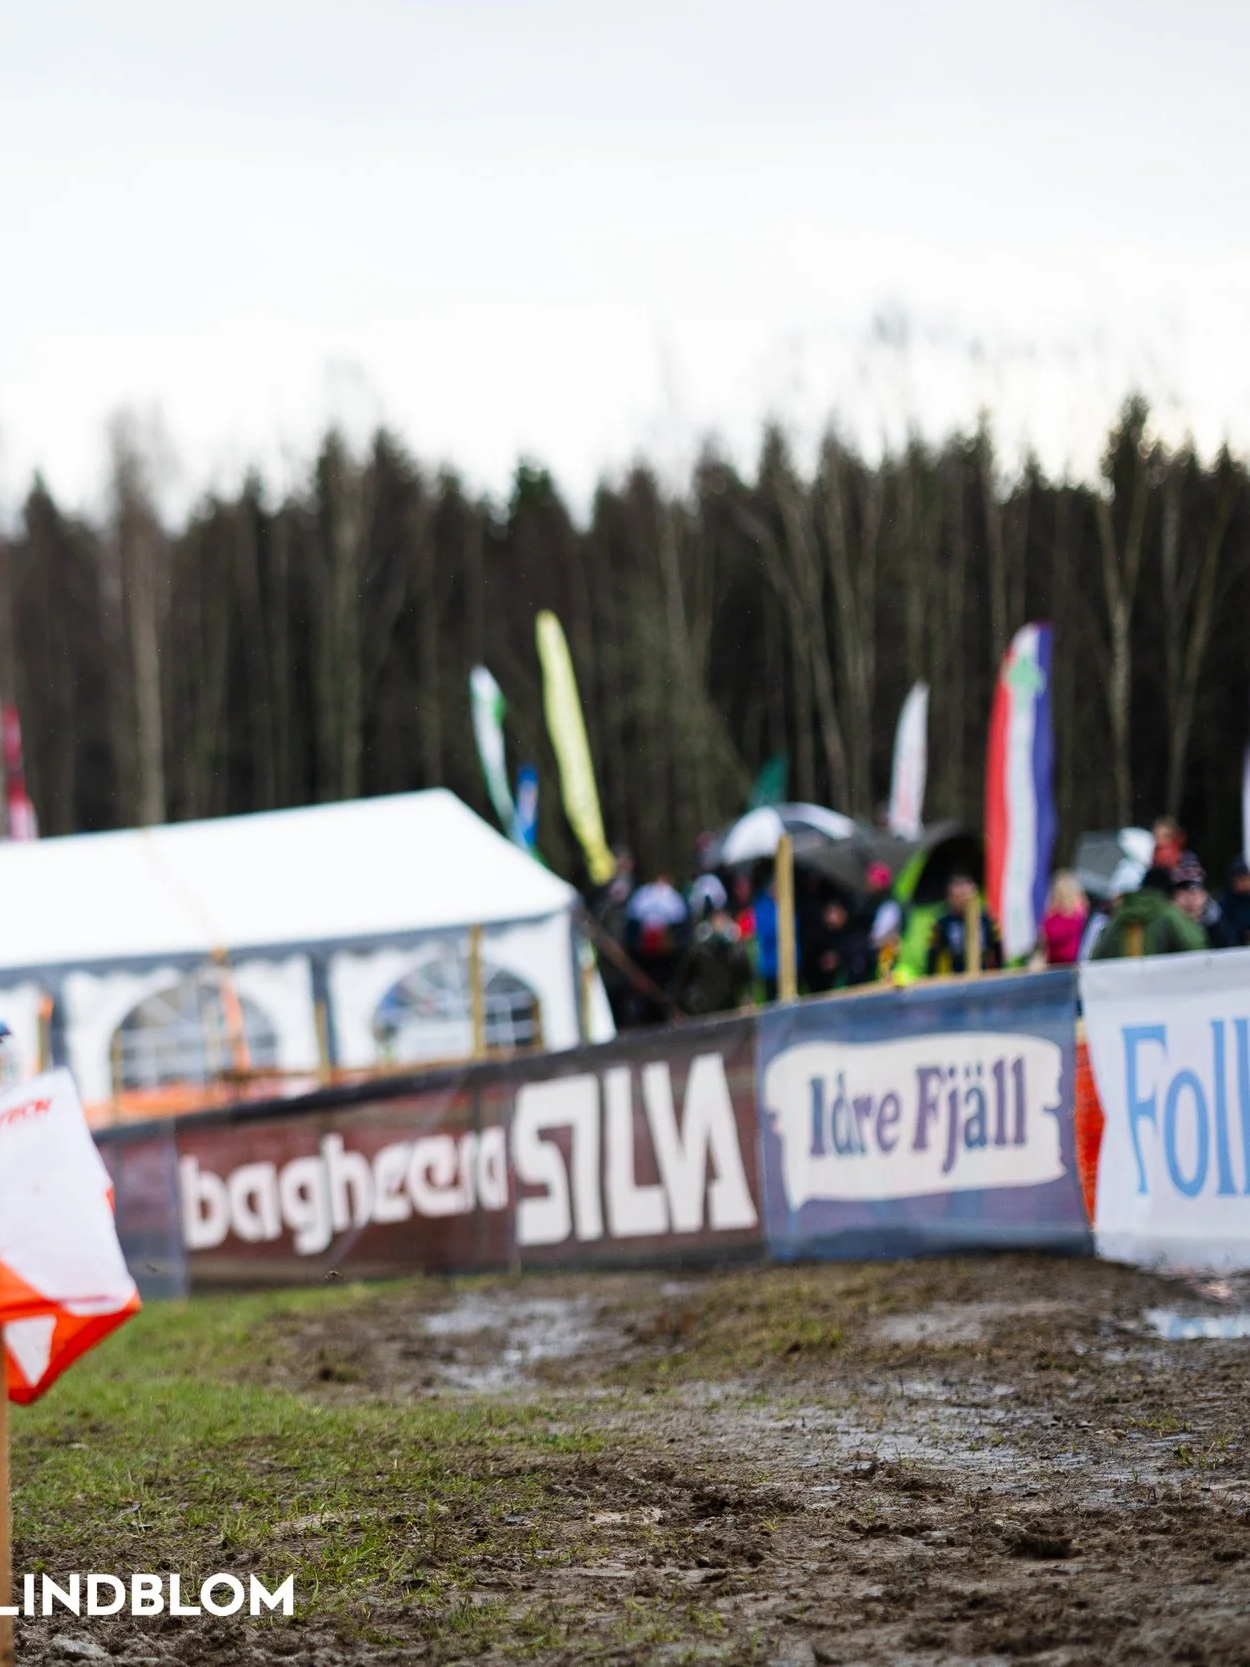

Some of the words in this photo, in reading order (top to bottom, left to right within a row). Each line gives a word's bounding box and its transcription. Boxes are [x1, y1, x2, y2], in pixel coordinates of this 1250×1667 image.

[514, 1053, 758, 1246] SILVA
[809, 1070, 901, 1157] Idre
[912, 1056, 1027, 1174] Fjäll
[180, 1126, 509, 1255] bagheera
